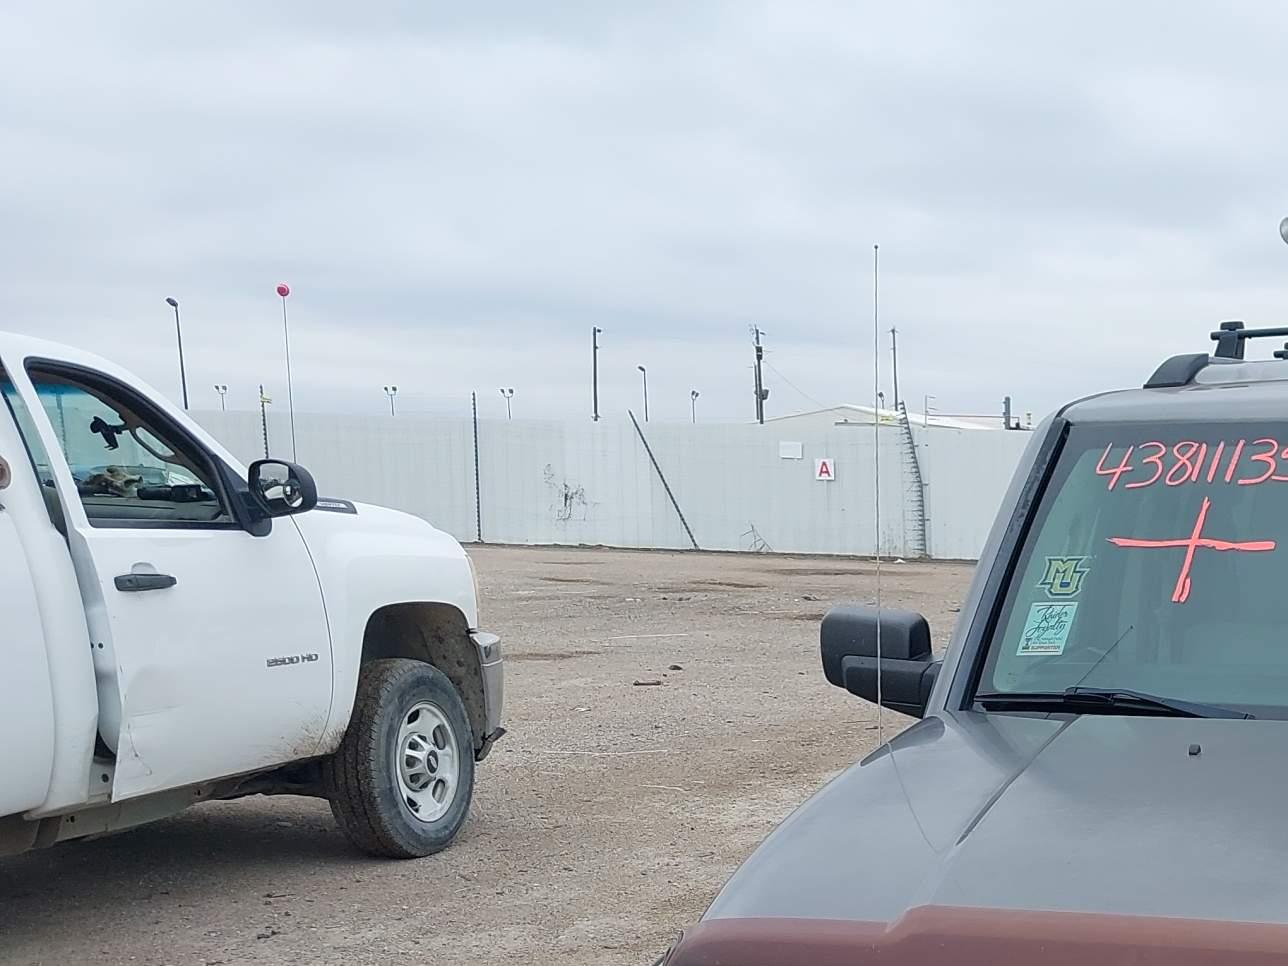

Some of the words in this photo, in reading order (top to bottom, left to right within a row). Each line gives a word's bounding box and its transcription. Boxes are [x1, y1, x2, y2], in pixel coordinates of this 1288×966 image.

[818, 461, 831, 477] A
[1036, 556, 1090, 598] MU
[300, 653, 319, 663] HD
